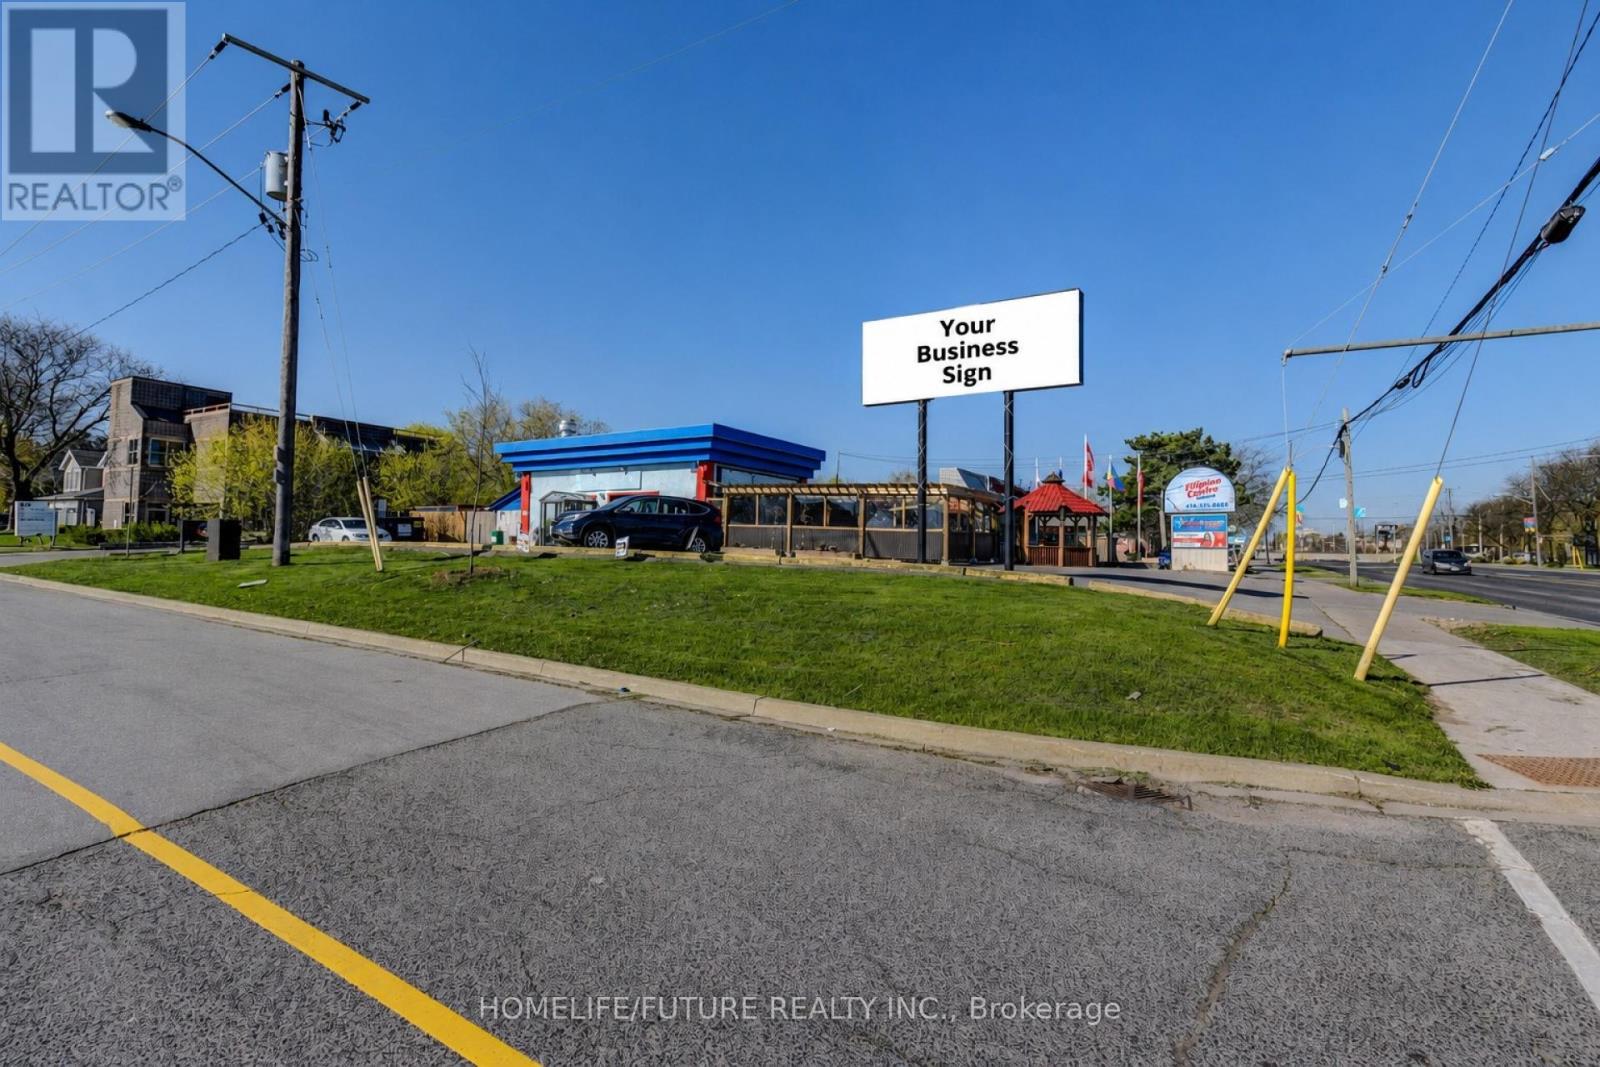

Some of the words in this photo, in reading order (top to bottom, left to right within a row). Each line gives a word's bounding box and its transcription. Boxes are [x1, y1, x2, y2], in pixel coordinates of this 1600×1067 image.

[940, 318, 996, 337] Your
[917, 339, 1019, 363] Business
[942, 364, 992, 387] Sign
